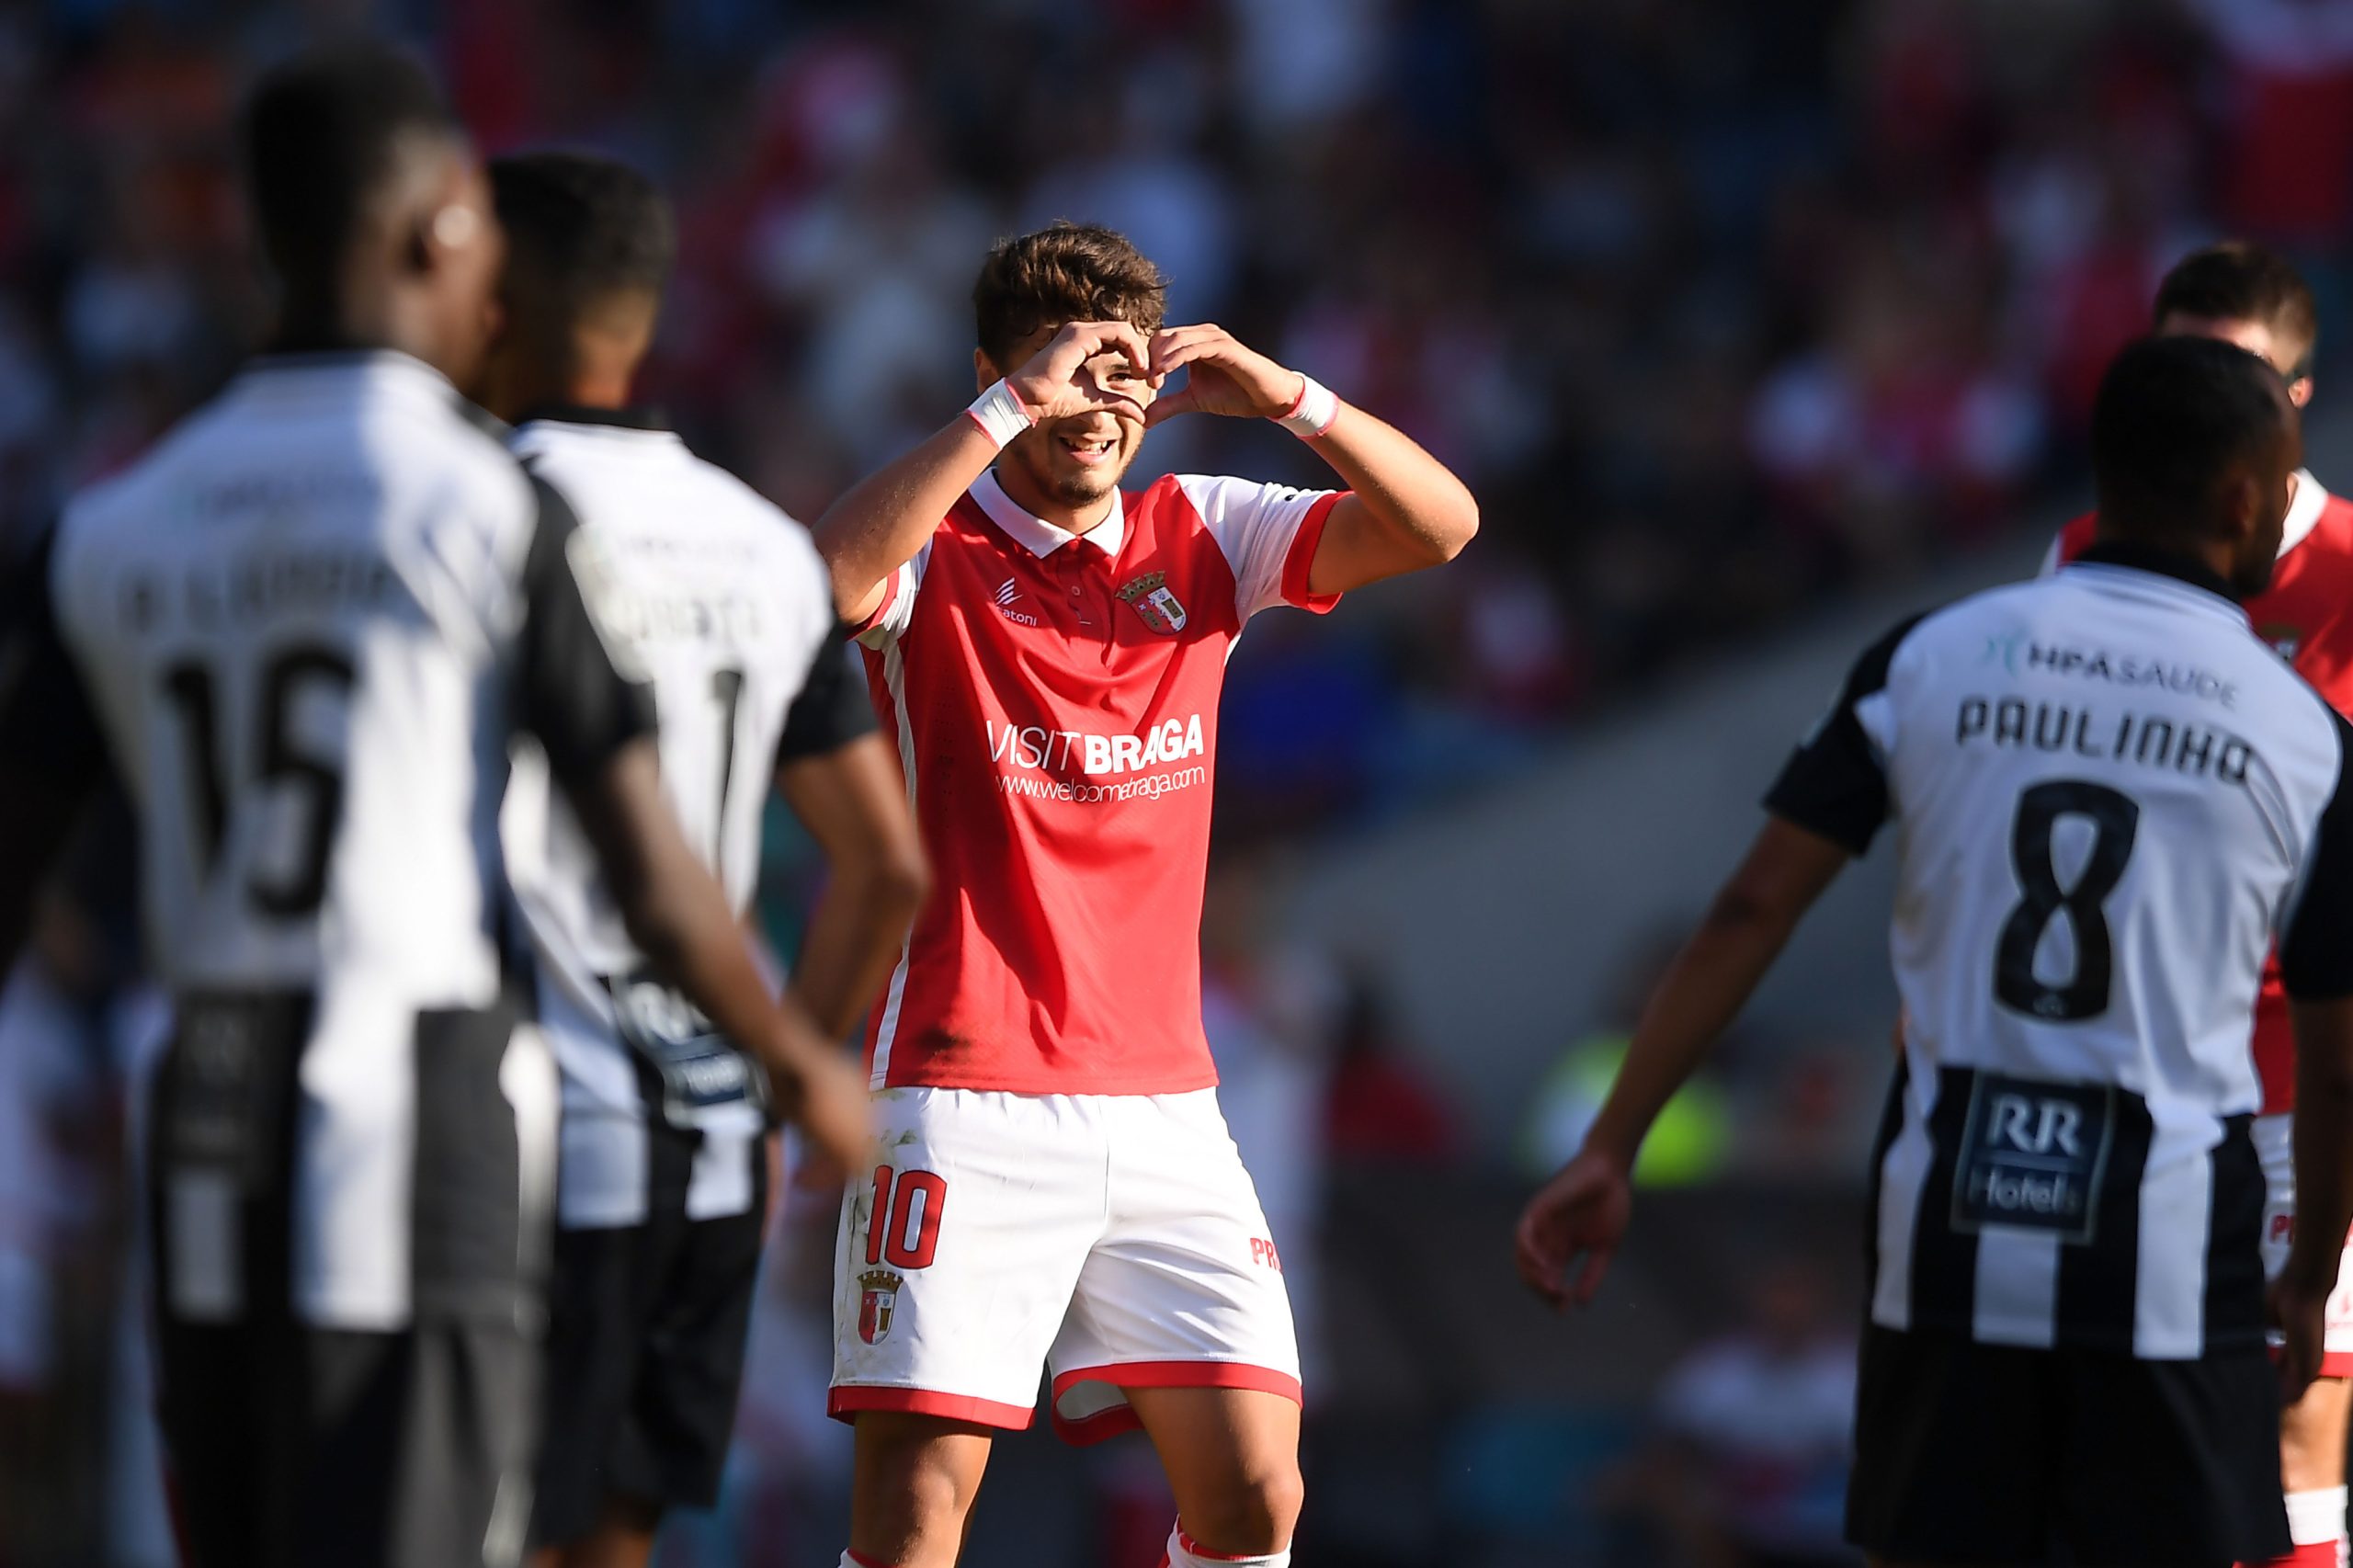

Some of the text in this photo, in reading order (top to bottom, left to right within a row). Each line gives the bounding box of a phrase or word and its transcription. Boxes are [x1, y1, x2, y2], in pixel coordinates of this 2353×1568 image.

[986, 714, 1204, 775] VISIT BRAGA
[1956, 696, 2250, 784] PAULINHO
[1992, 779, 2140, 1025] 8
[1985, 1092, 2083, 1155] RR
[866, 1165, 948, 1269] 10
[1250, 1237, 1282, 1273] PR
